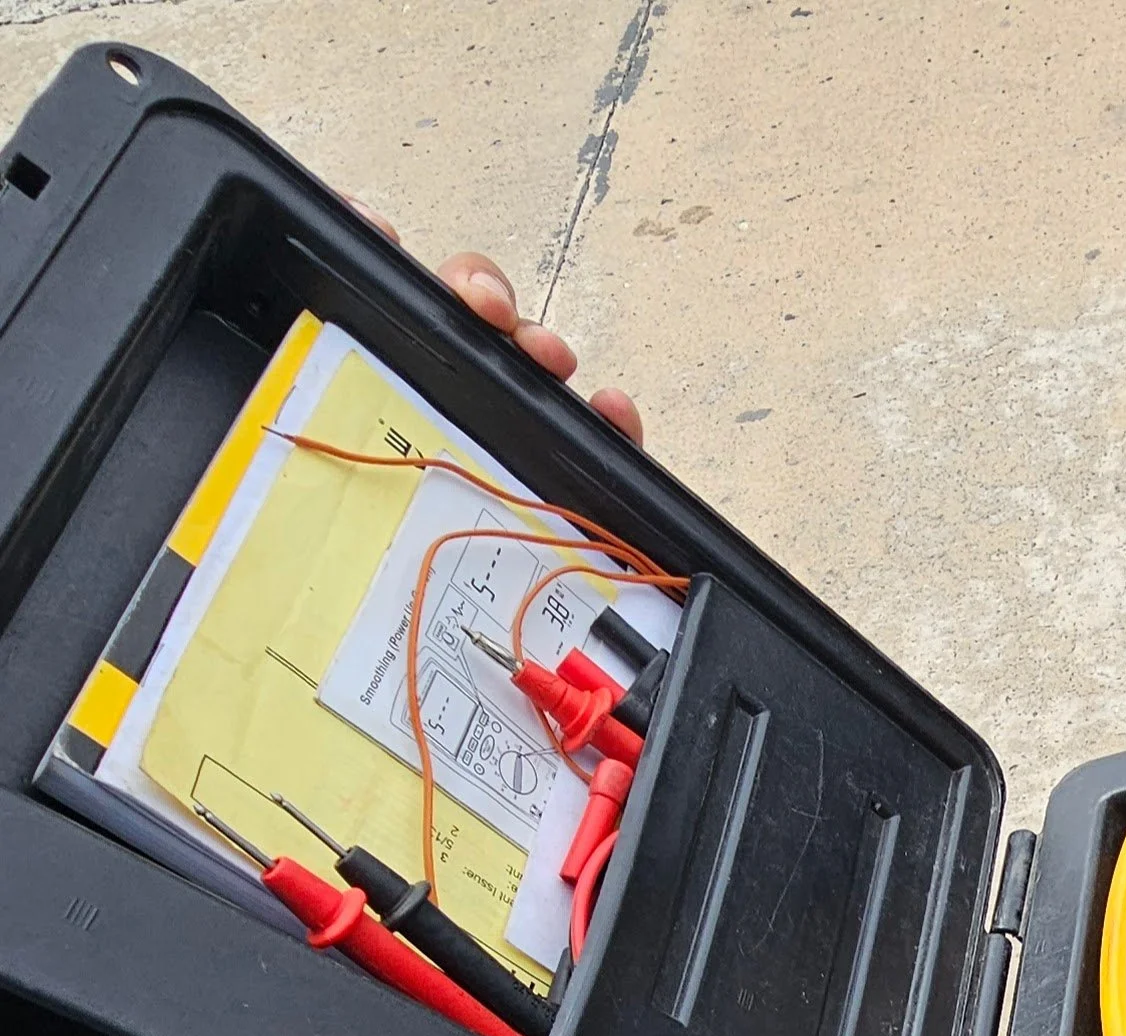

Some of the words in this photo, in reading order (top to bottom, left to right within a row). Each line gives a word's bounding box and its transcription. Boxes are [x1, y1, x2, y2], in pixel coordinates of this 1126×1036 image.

[360, 655, 396, 706] Smoothing
[389, 617, 411, 655] (Power
[440, 852, 449, 863] 3
[462, 866, 497, 896] Issue:
